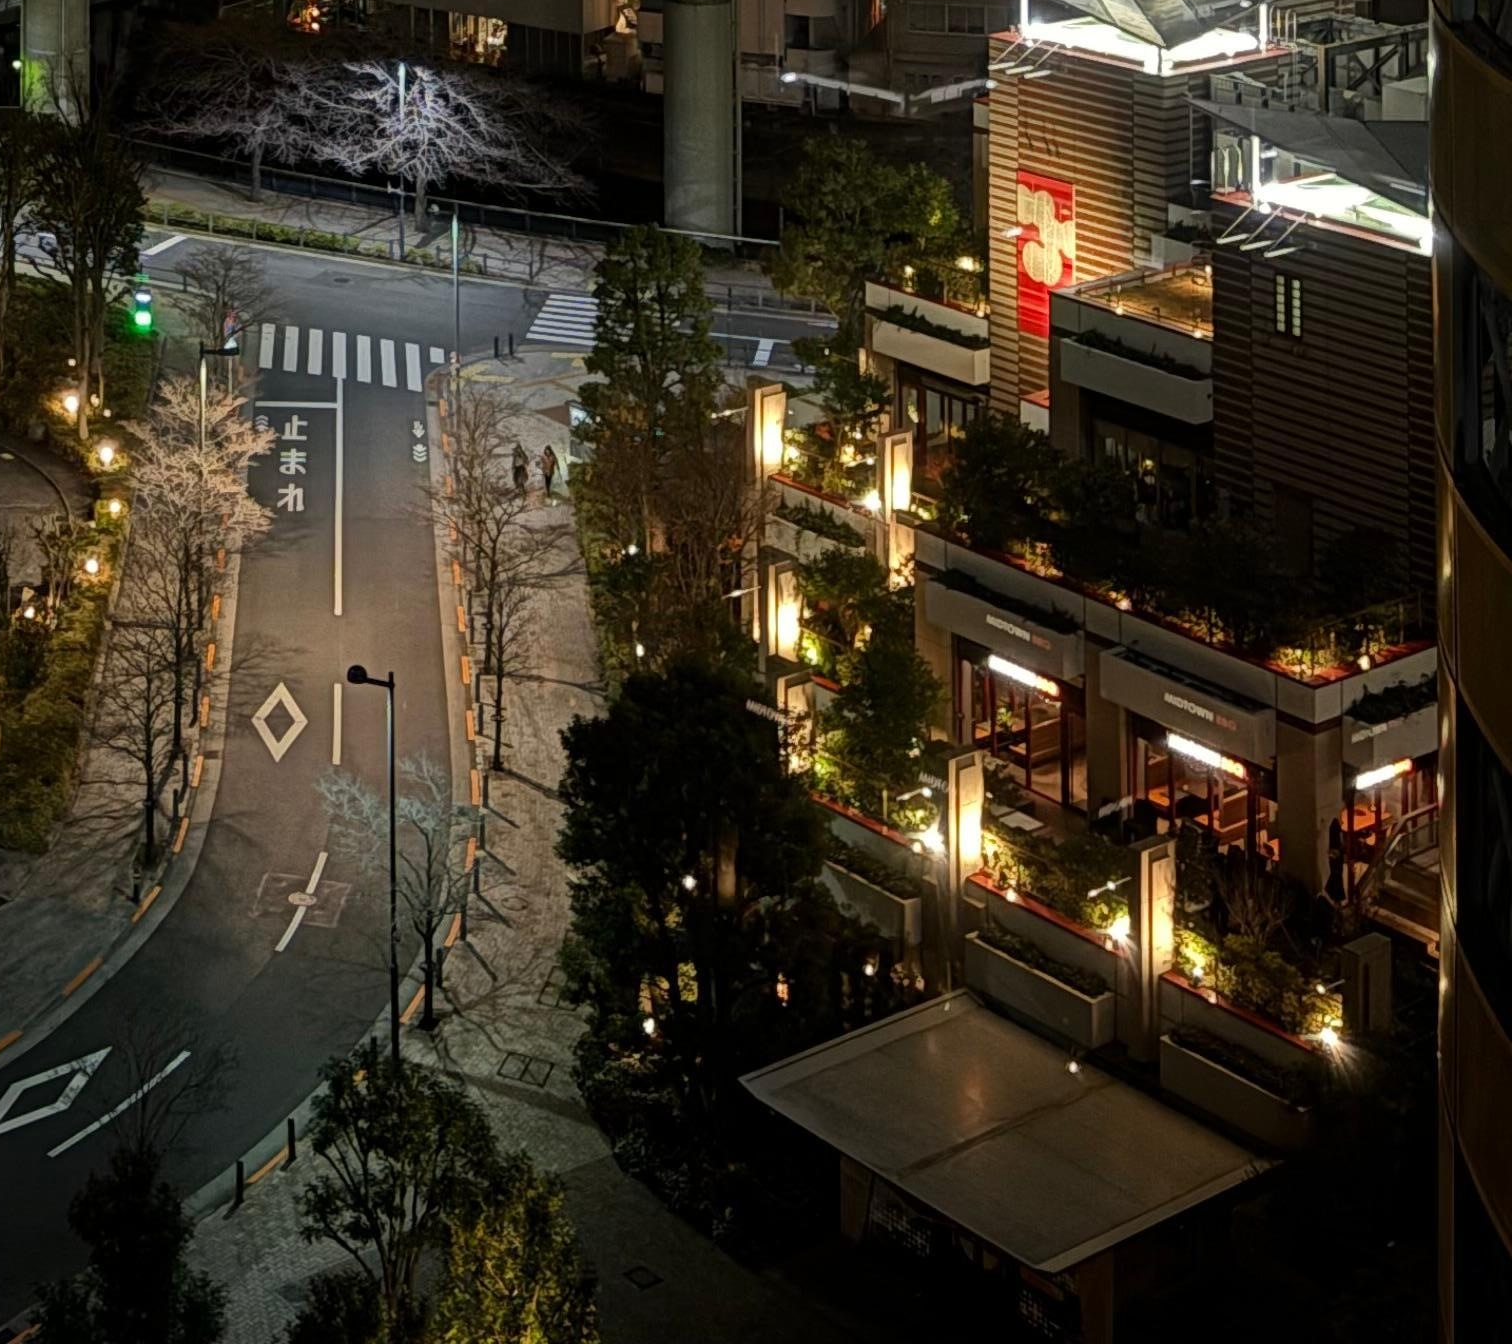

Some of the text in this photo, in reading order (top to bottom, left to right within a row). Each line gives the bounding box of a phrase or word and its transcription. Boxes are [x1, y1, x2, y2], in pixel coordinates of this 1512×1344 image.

[276, 414, 308, 512] 止まれ
[1164, 692, 1214, 723] MIDTOWN
